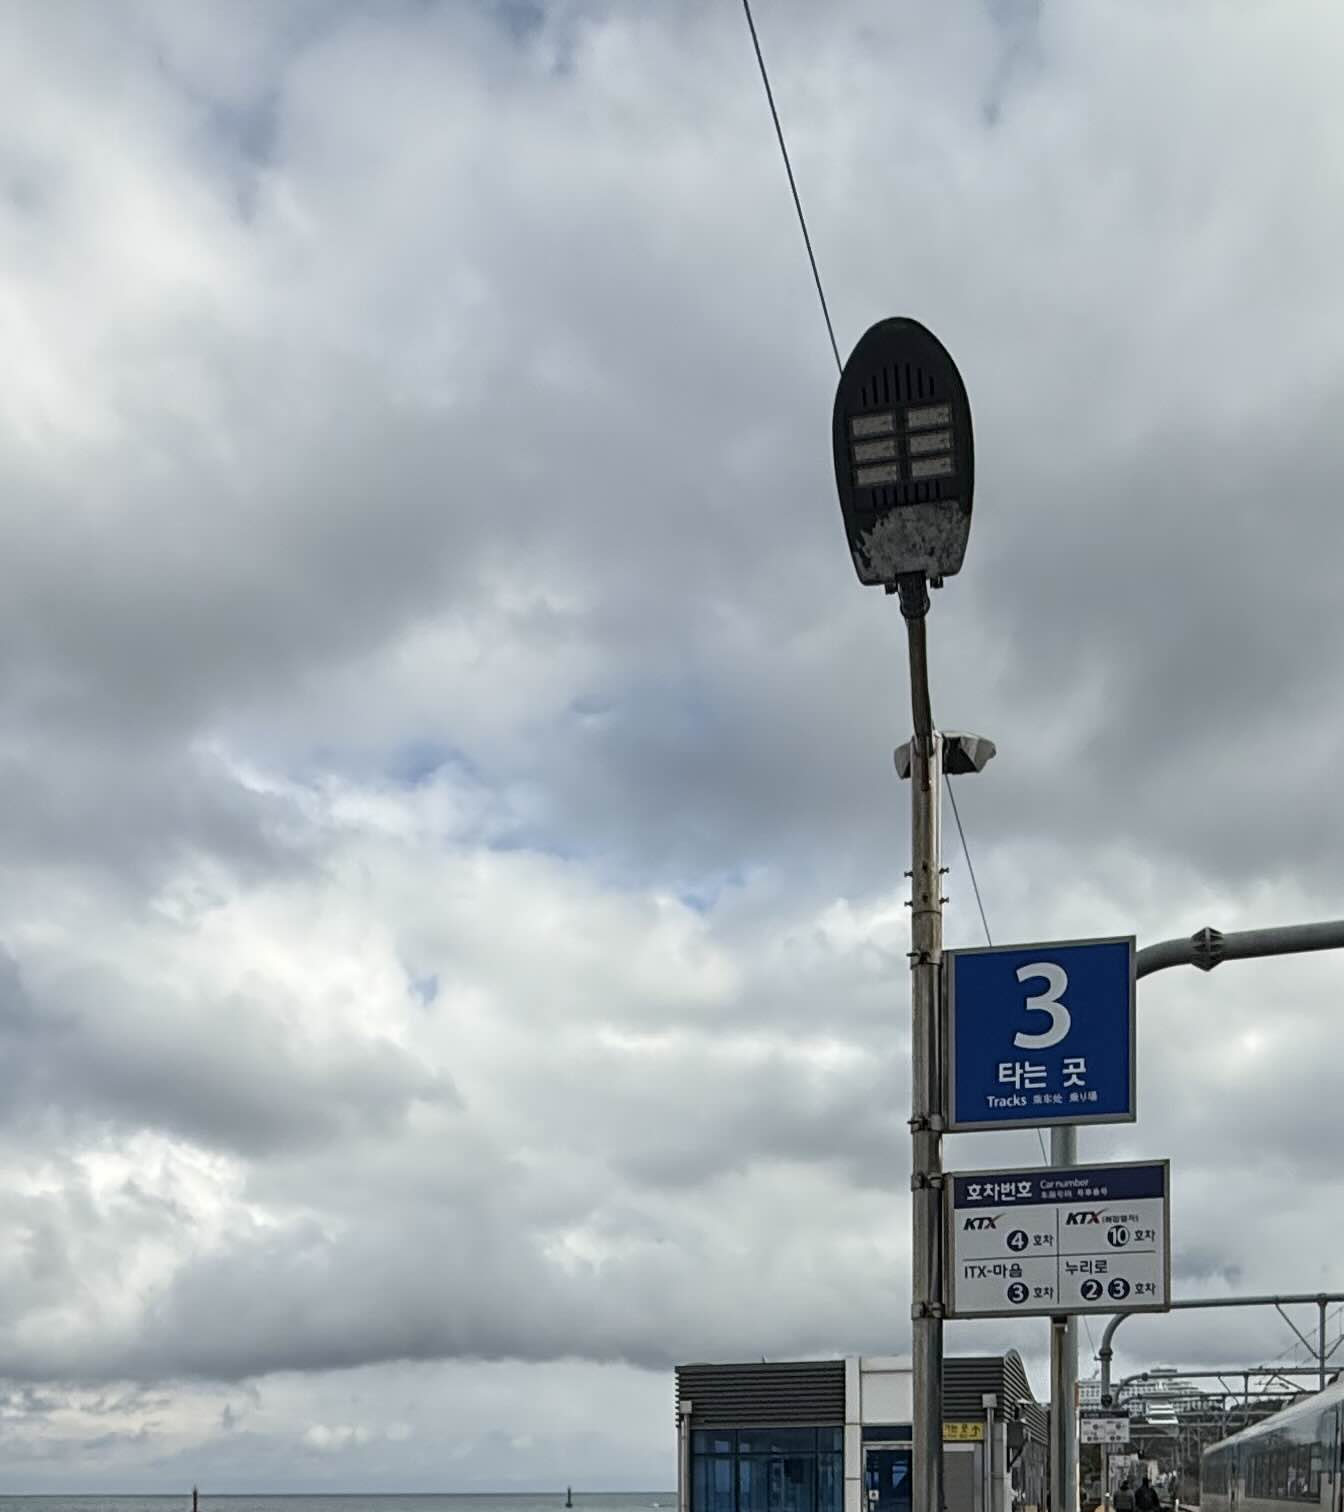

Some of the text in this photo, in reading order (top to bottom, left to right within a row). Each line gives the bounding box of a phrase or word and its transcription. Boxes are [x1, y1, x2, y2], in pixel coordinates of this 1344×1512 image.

[1013, 962, 1072, 1049] 3
[998, 1057, 1087, 1090] 타는 곳
[987, 1094, 1027, 1108] Tracks
[967, 1181, 1032, 1200] 호차번호
[1040, 1178, 1089, 1189] Car number
[963, 1214, 1002, 1230] KTX
[1065, 1209, 1105, 1225] KTX
[1009, 1231, 1054, 1250] 4 호차
[1109, 1226, 1156, 1246] 10 호차
[964, 1263, 1023, 1279] ITX-마음
[1065, 1260, 1108, 1275] 누리로
[1010, 1283, 1054, 1302] 3 호차
[1084, 1279, 1156, 1300] 2 3 호차
